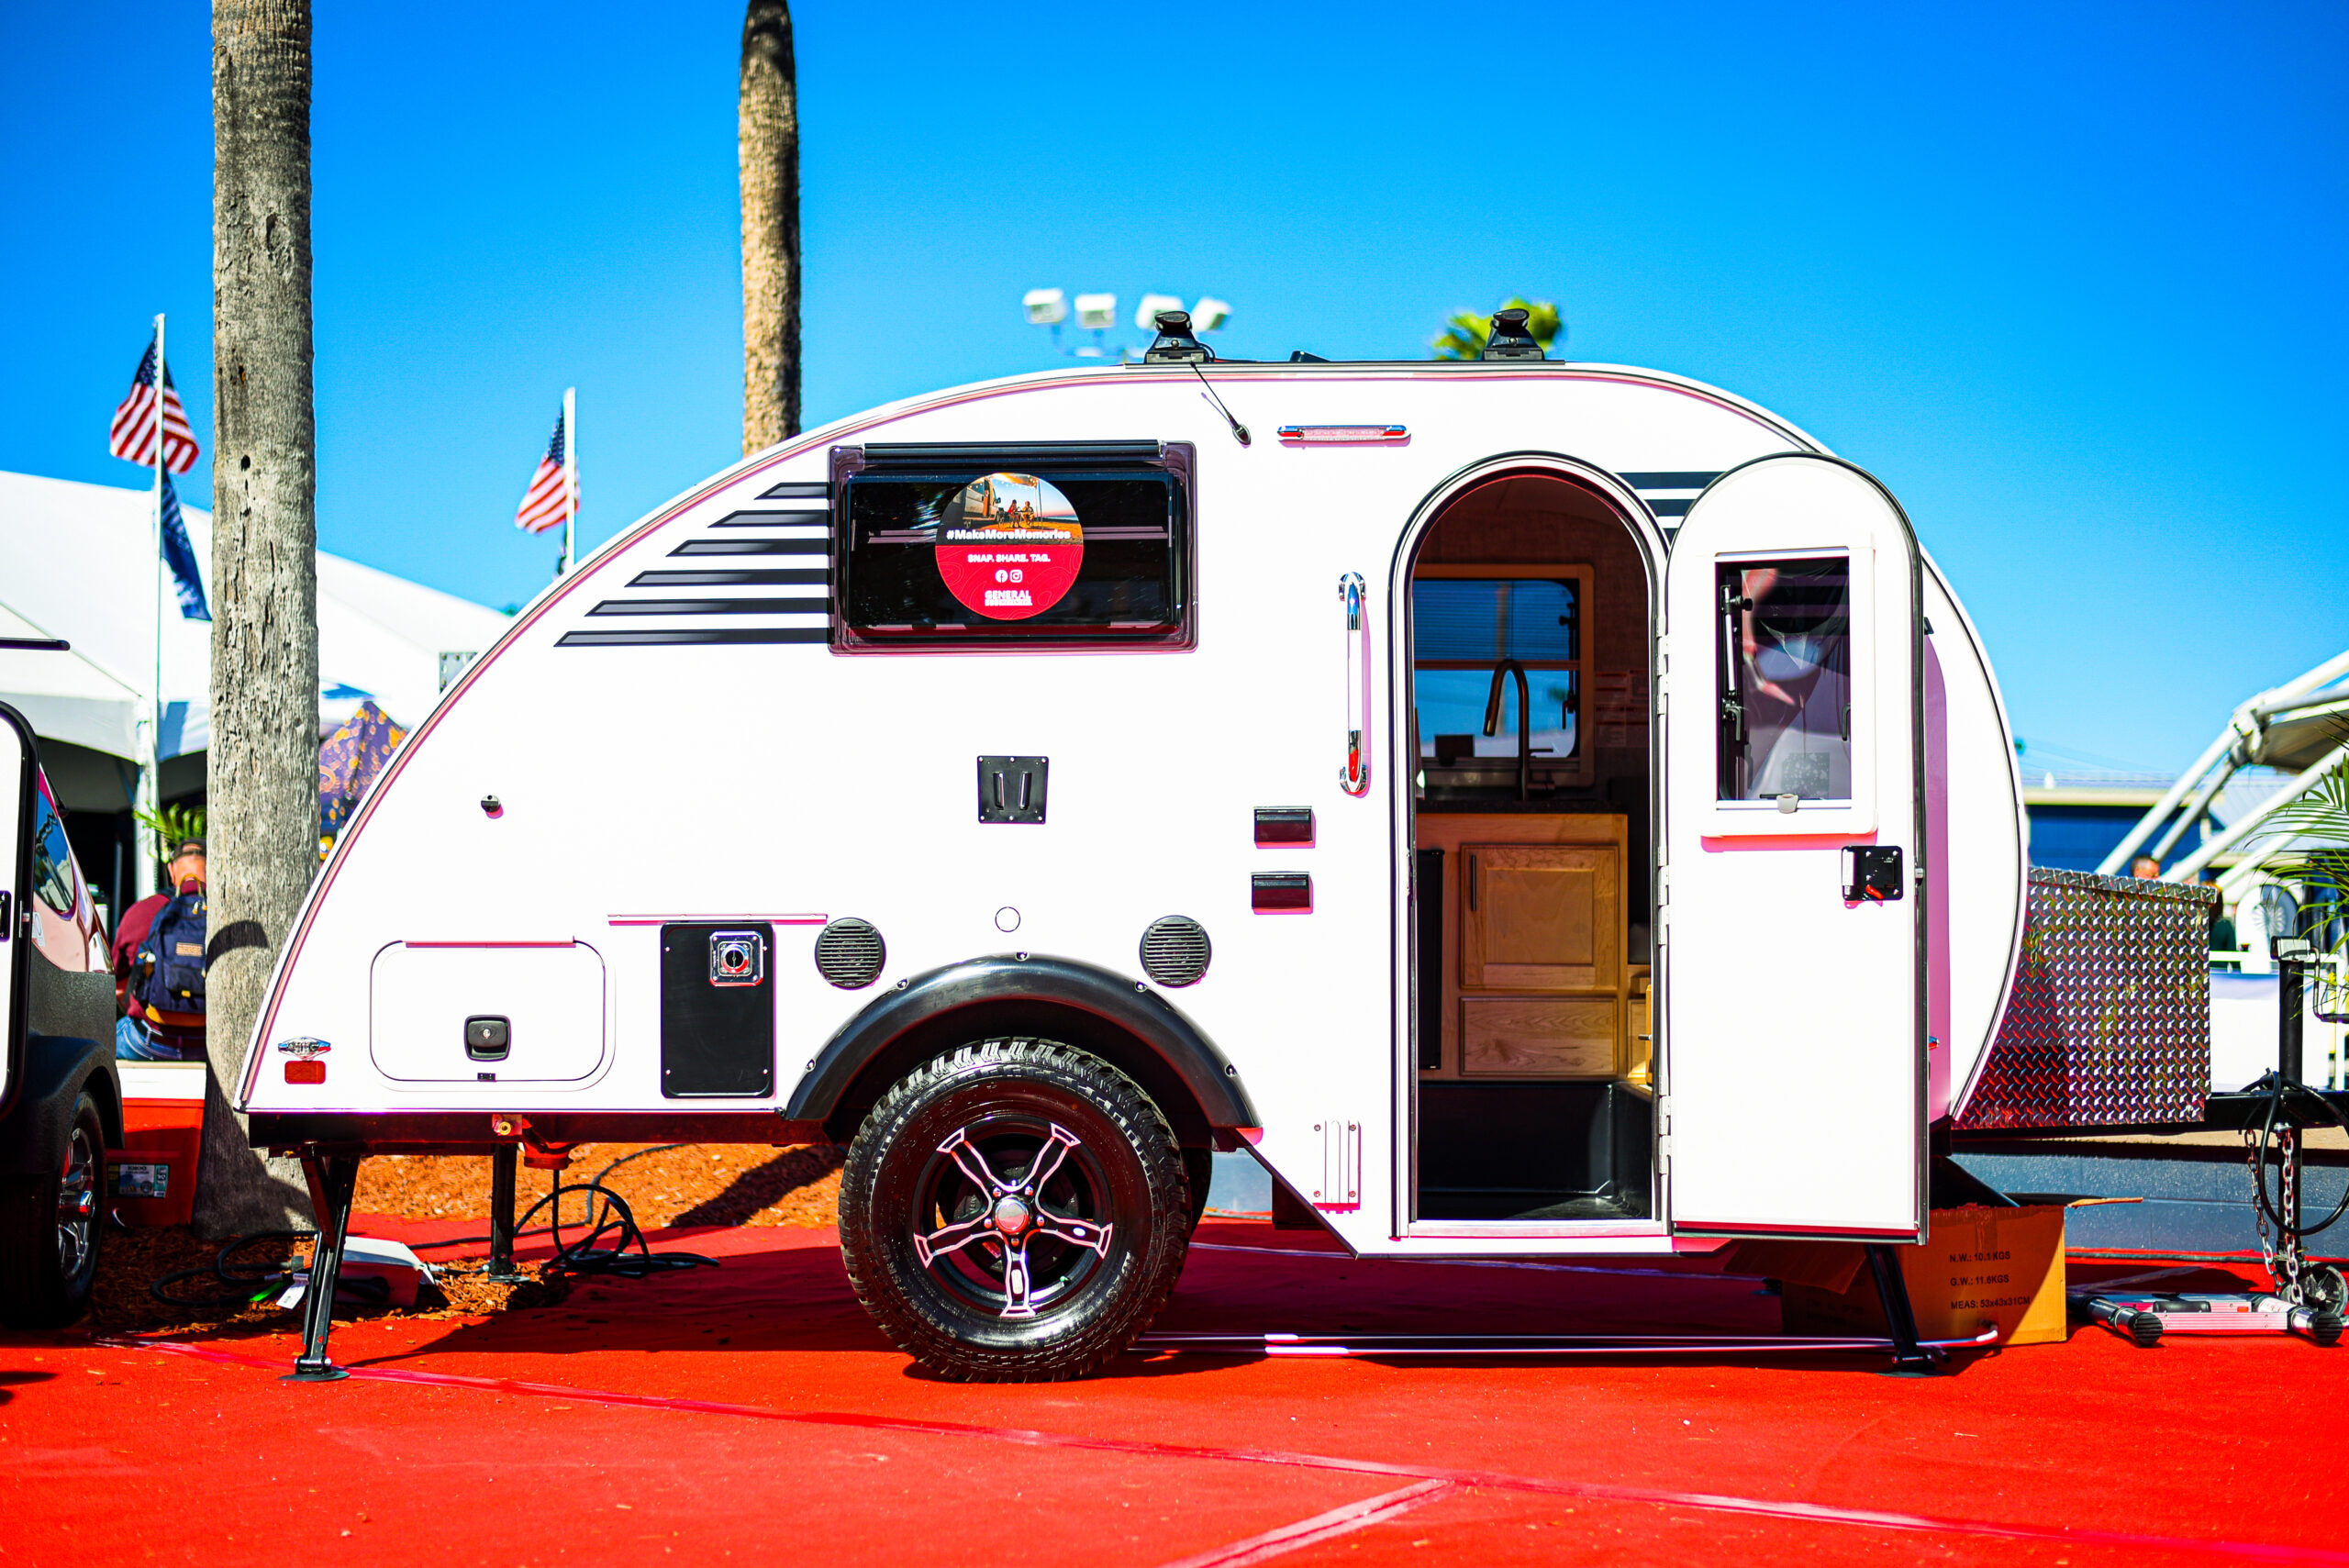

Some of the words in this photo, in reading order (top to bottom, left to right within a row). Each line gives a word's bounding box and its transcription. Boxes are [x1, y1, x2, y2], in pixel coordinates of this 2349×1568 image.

[946, 529, 1072, 540] #MakeMoreMemories
[967, 554, 995, 562] SNAP.
[996, 554, 1029, 562] SHARE.
[1030, 553, 1051, 562] TAG.
[985, 589, 1031, 600] GENERAL
[1949, 1253, 1972, 1263] N.W.:
[1974, 1252, 1991, 1262] 10.1
[1992, 1251, 2011, 1261] KGS
[1950, 1276, 1973, 1286] G.W.:
[1951, 1299, 1979, 1309] MEAS:
[1980, 1296, 2031, 1307] 53x43x31CM
